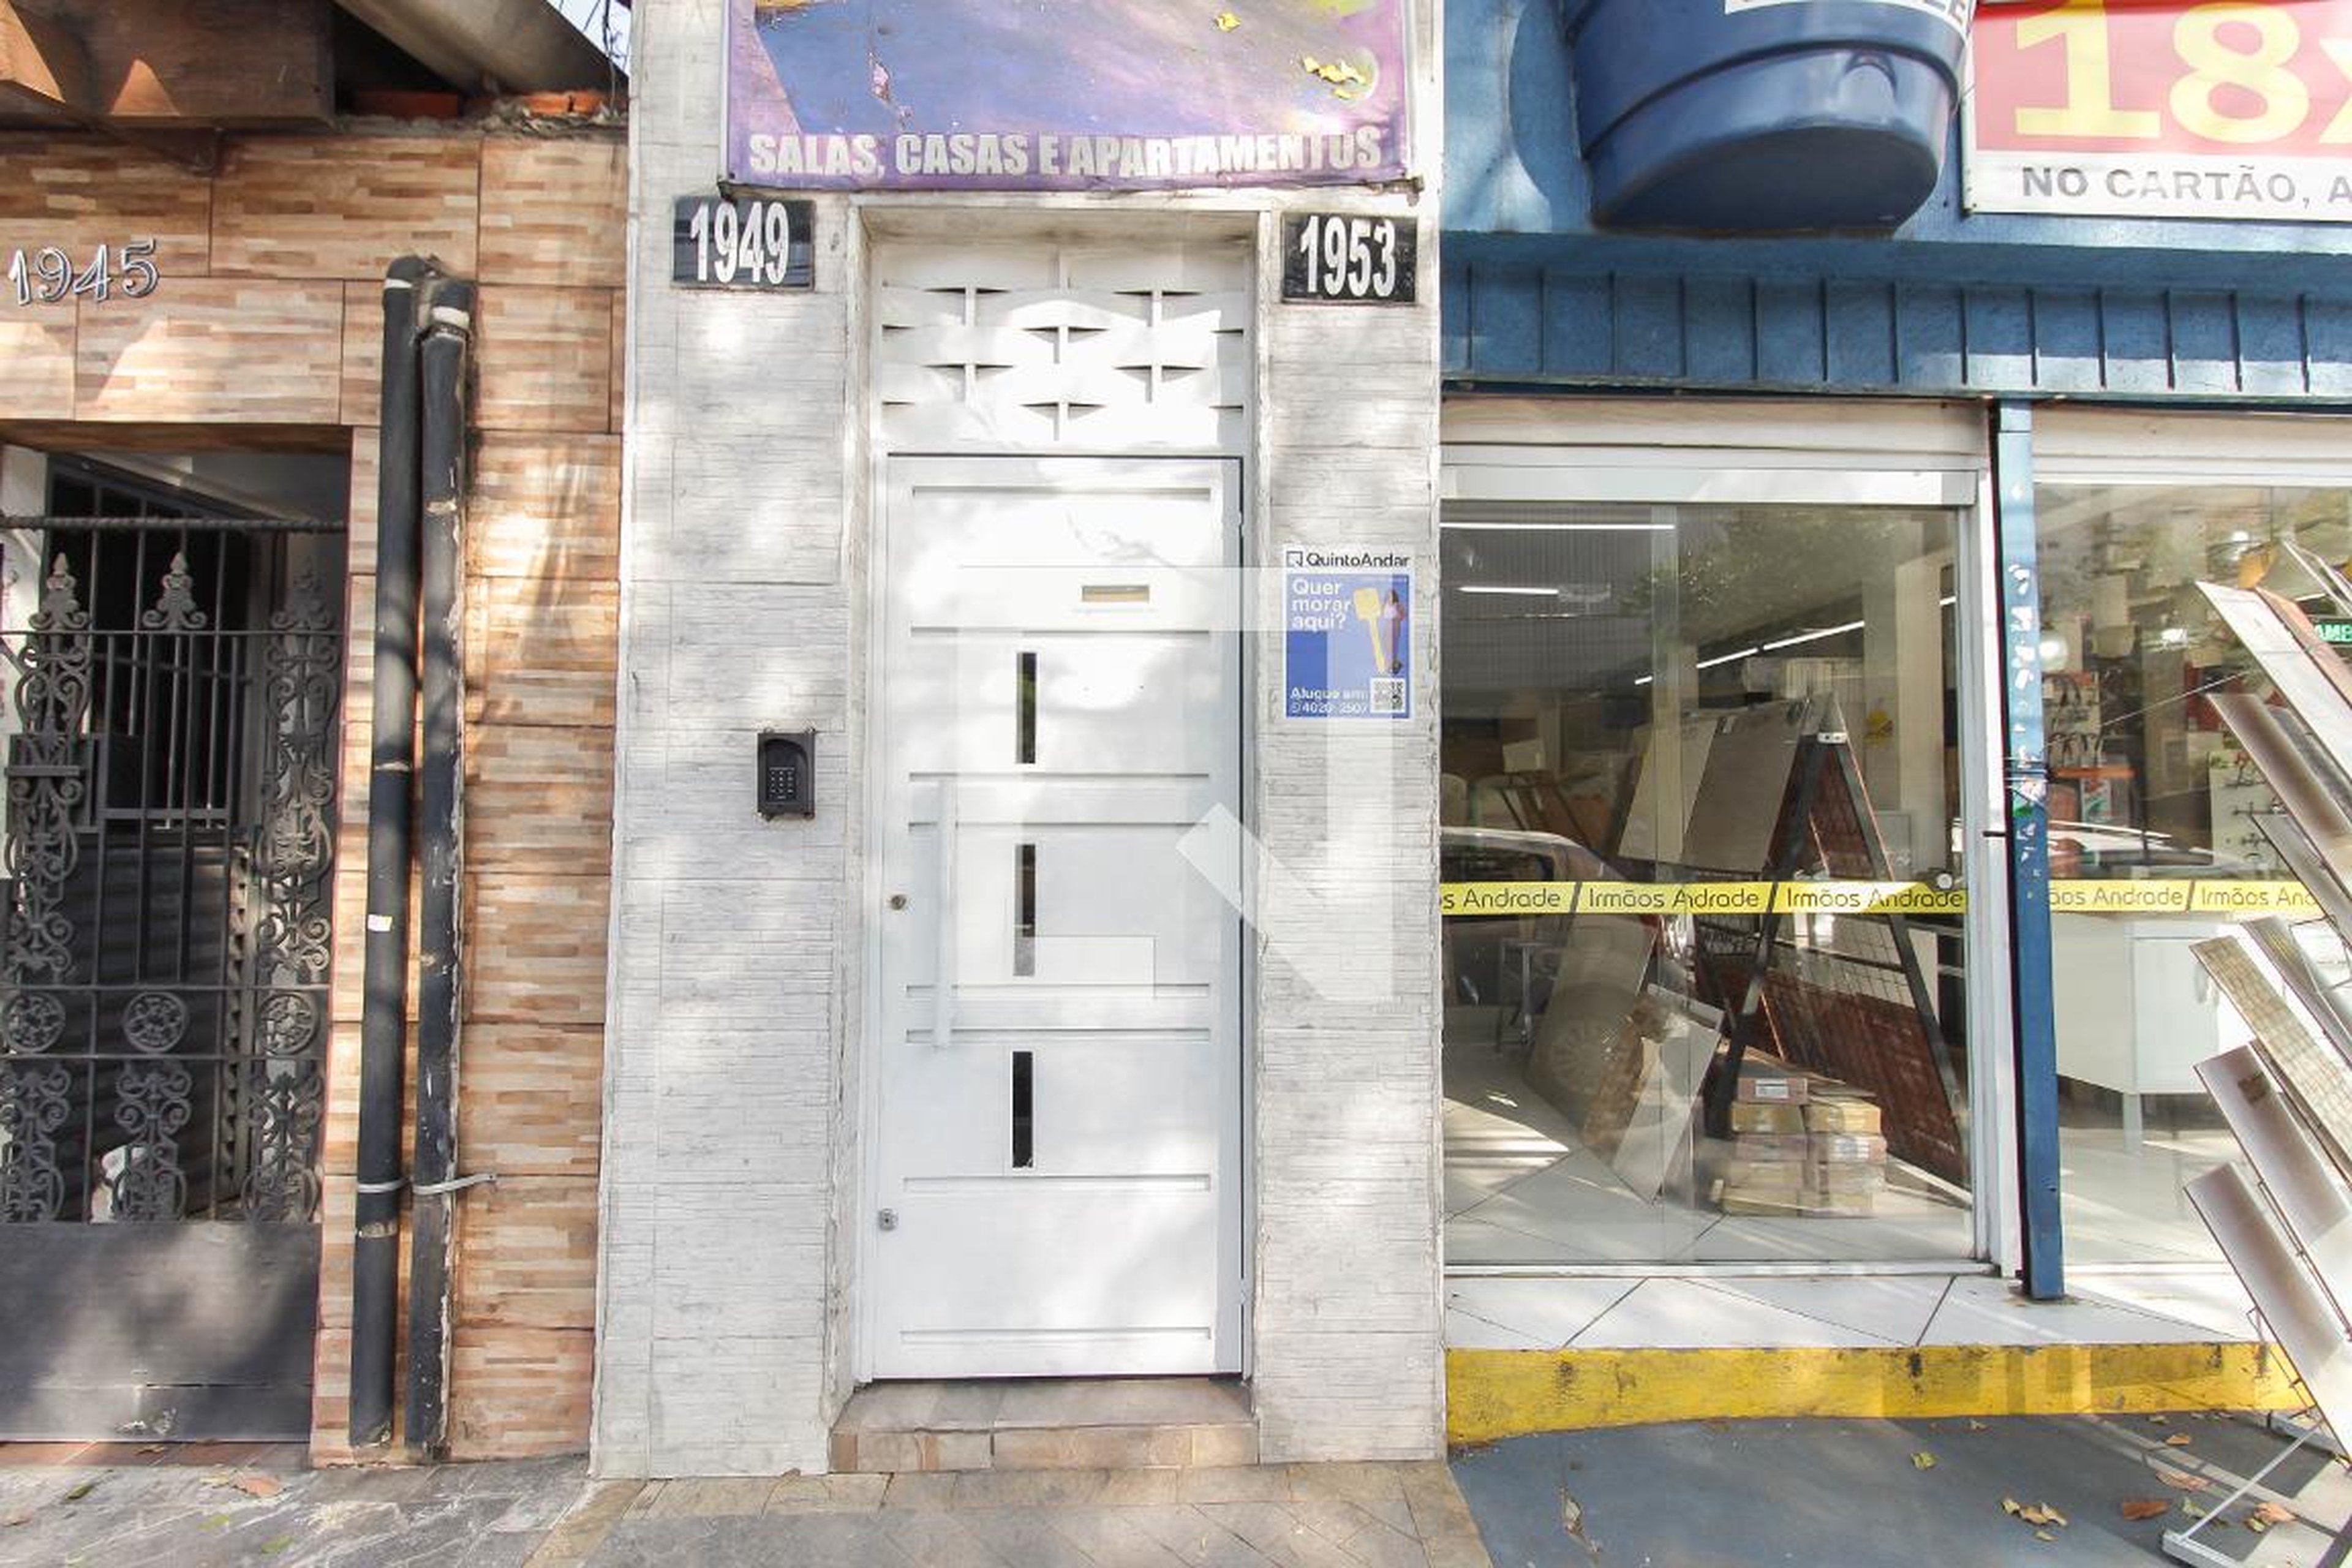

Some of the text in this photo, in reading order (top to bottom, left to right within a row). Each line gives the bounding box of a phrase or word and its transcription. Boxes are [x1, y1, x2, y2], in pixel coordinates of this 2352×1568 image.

[750, 134, 885, 179] SALAS,
[896, 134, 1028, 175] CASAS
[1040, 134, 1060, 175] E
[2022, 167, 2089, 197] NO
[2105, 164, 2310, 209] CARTÃO,
[690, 202, 790, 284] 1949
[1300, 215, 1396, 297] 1953
[8, 236, 160, 306] 1945
[1306, 552, 1410, 567] QuintoAndar
[1292, 578, 1341, 595] Quer
[1292, 599, 1351, 611] morar
[1292, 613, 1346, 632] aqui?
[1463, 888, 1561, 909] Andrade
[1589, 888, 1665, 907] Irmãos
[1787, 888, 1860, 907] Irmãos
[1868, 888, 1964, 908] Andrade
[2094, 887, 2182, 906] Andrade
[2201, 887, 2268, 906] Irmãos
